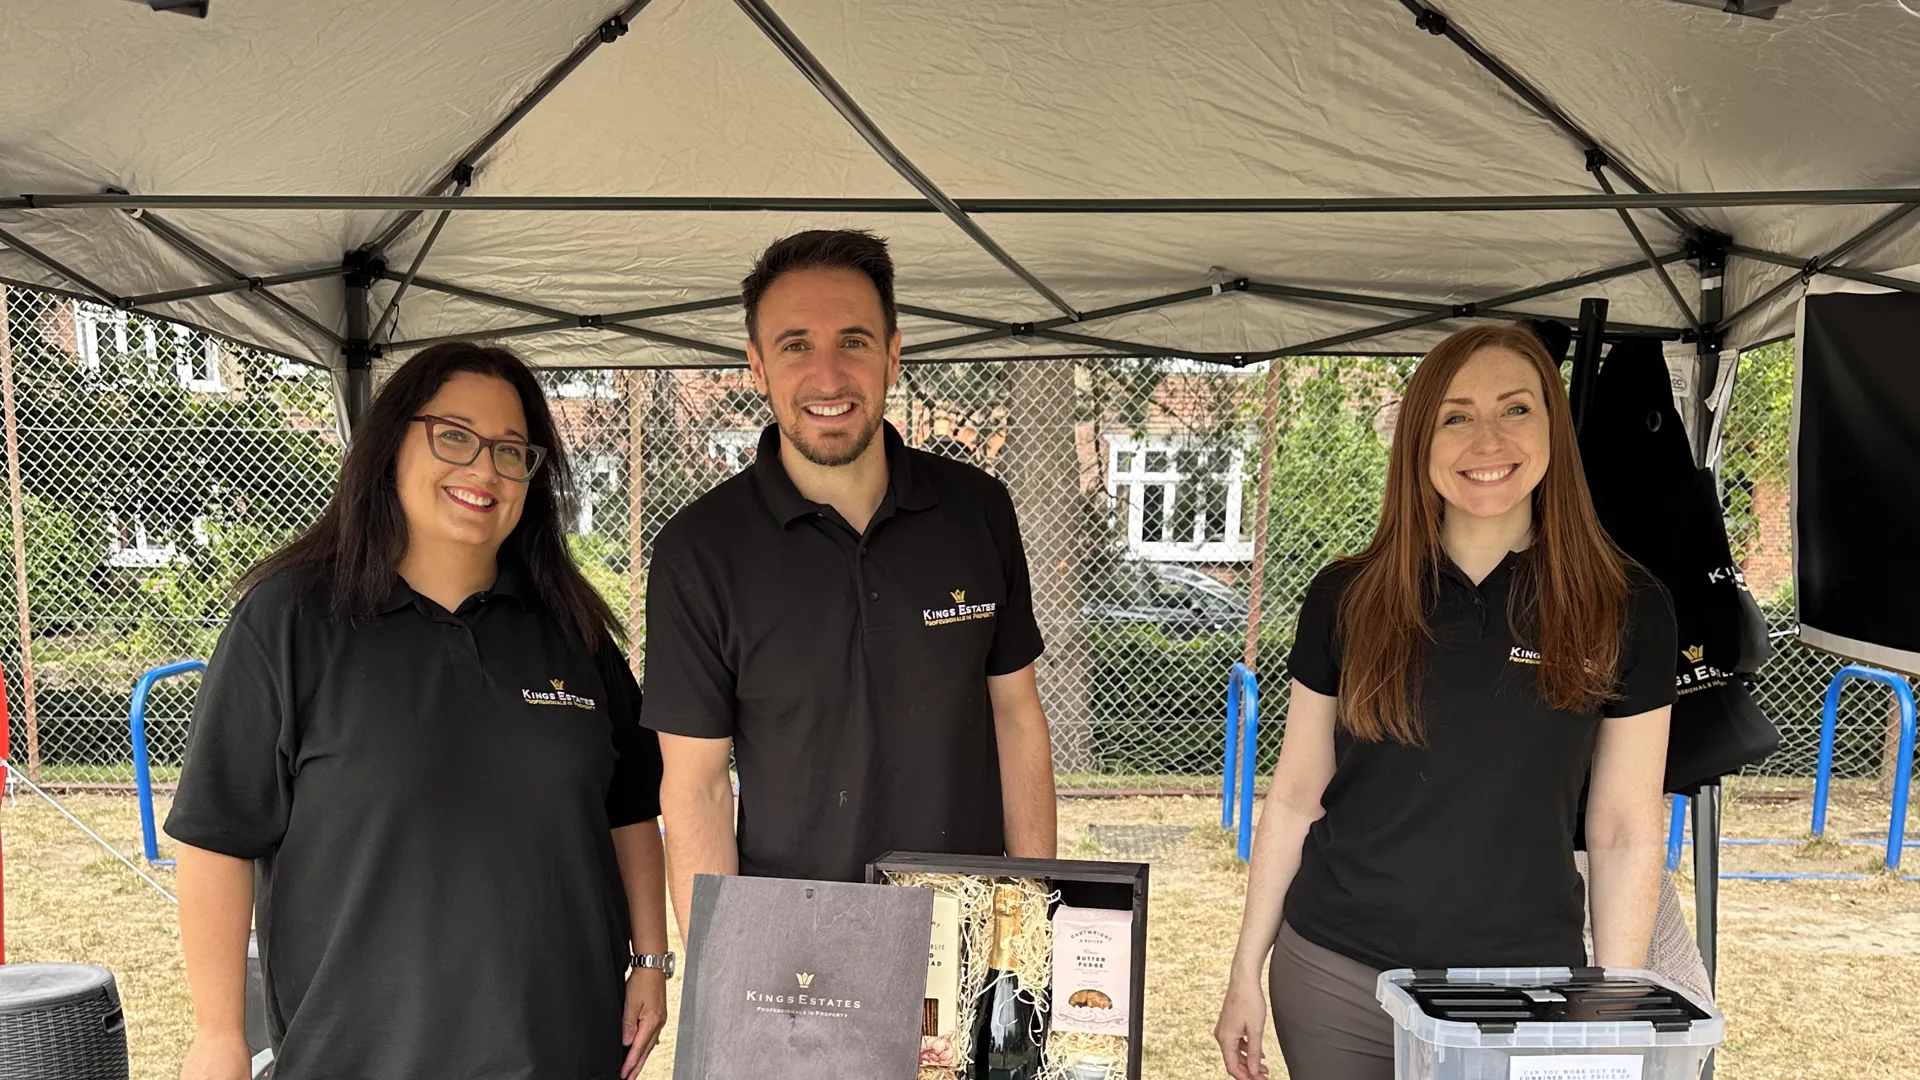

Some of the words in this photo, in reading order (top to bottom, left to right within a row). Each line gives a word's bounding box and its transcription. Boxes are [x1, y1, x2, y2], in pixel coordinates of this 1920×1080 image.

[923, 609, 956, 621] KINGS
[958, 603, 996, 616] ESTATES
[1510, 646, 1541, 660] KING
[521, 688, 556, 701] KINGS
[556, 691, 595, 706] ESTATES
[1078, 961, 1104, 969] FUDGE
[746, 990, 795, 1004] KINGS
[798, 994, 861, 1009] ESTATES
[815, 1010, 849, 1018] PROPERTY
